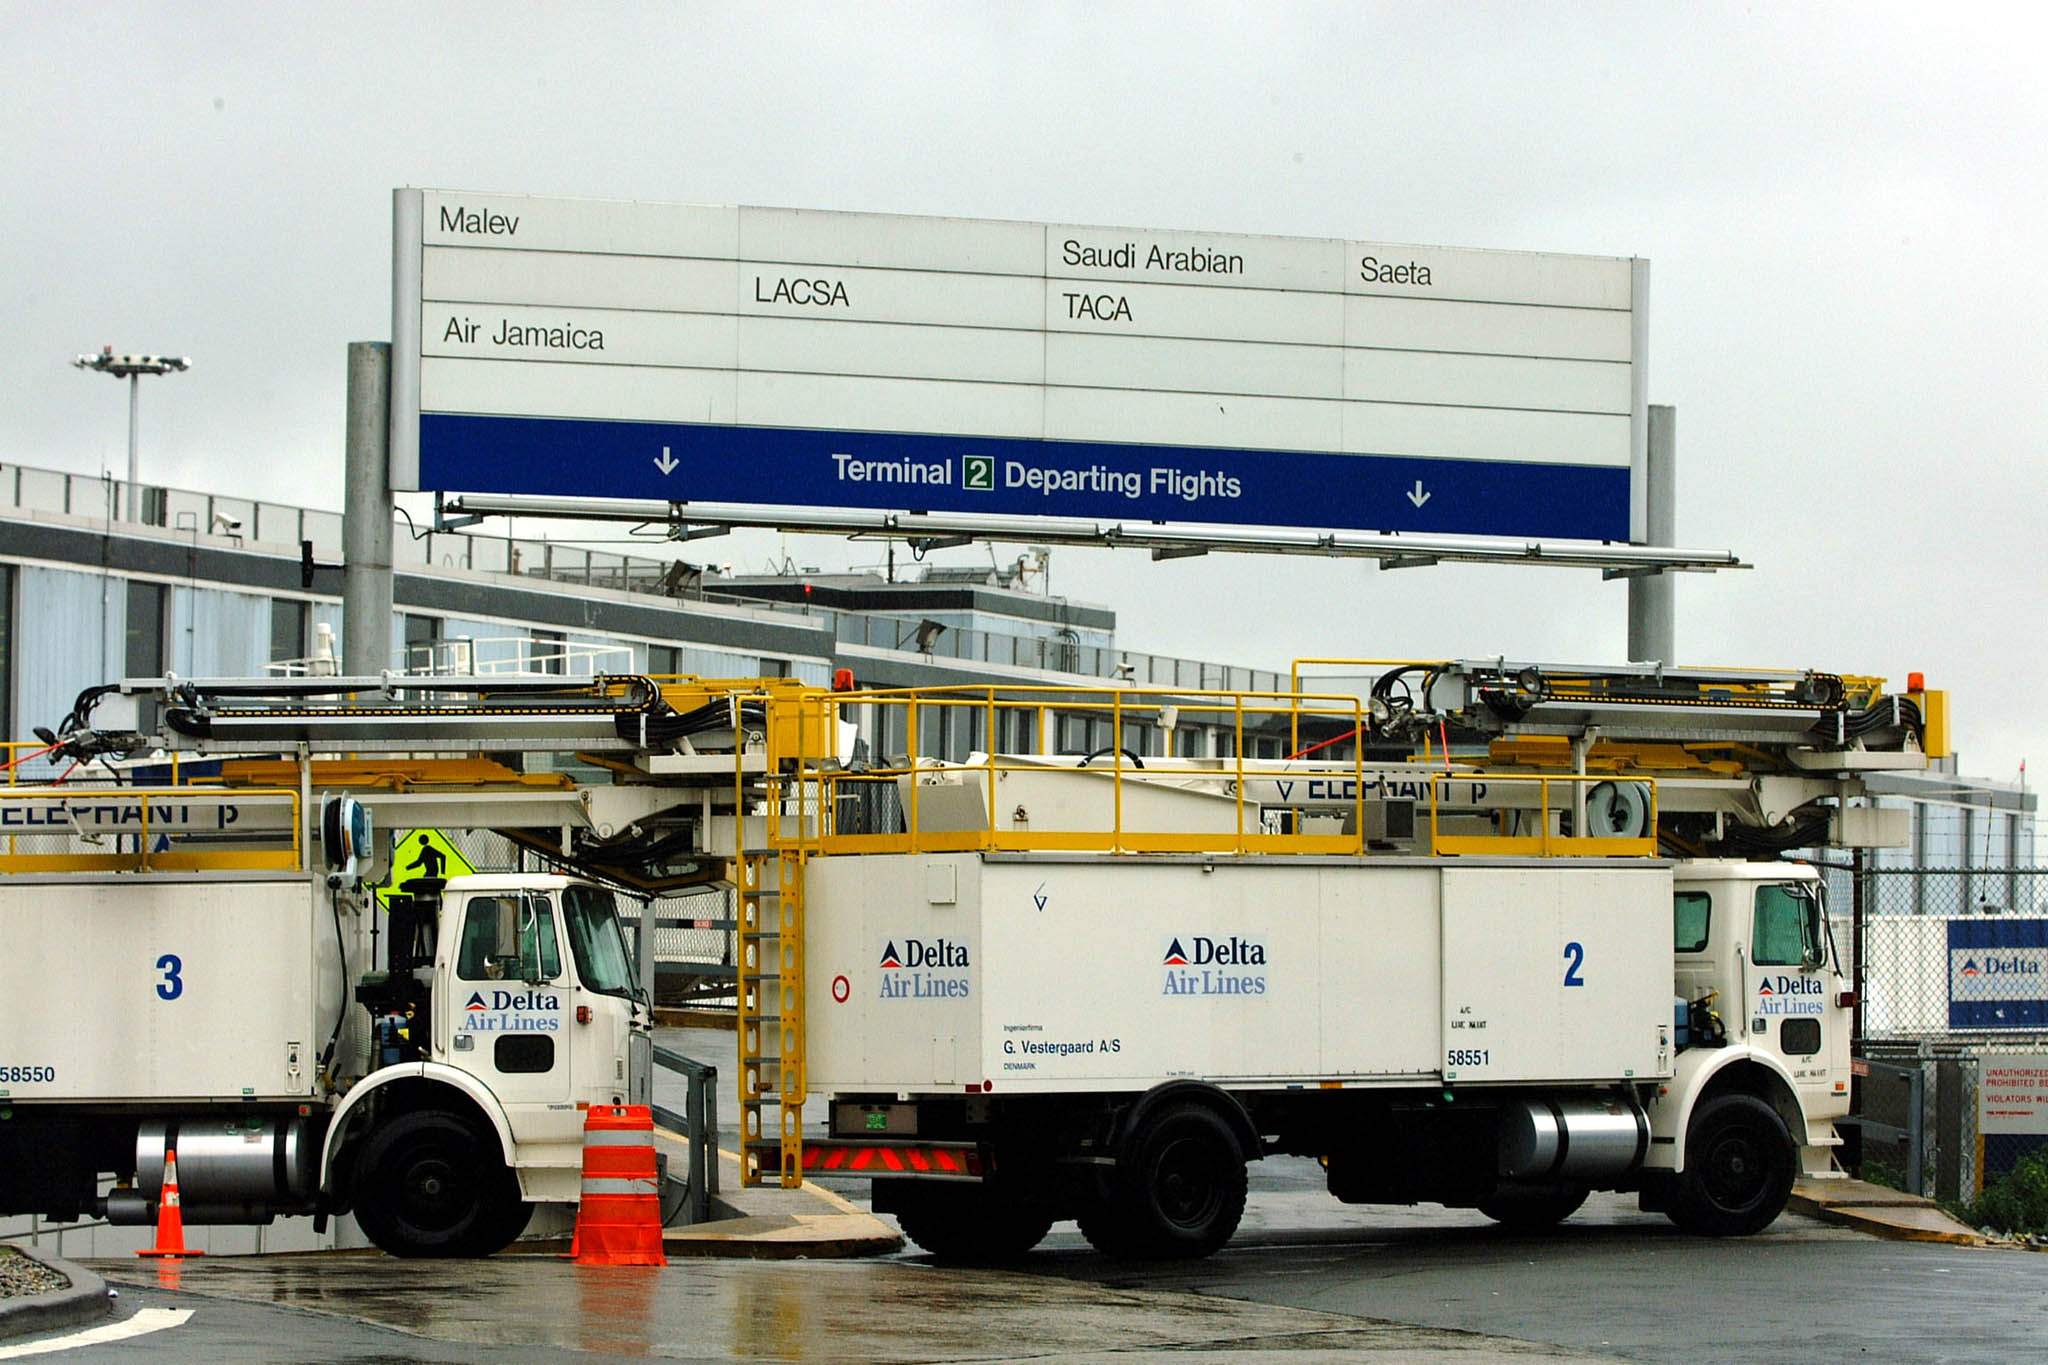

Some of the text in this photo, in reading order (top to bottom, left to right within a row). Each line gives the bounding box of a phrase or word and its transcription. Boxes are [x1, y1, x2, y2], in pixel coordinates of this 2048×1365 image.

[440, 206, 519, 235] Malev
[1062, 240, 1244, 274] Saudi Arabian
[1360, 256, 1433, 285] Saeta
[755, 277, 850, 307] LACSA
[1062, 293, 1133, 322] TACA
[443, 316, 605, 350] Air Jamaica
[831, 453, 1242, 501] Terminal 2 Departing Flights
[904, 938, 970, 968] Delta
[1192, 936, 1267, 965] Delta
[1563, 941, 1584, 987] 2
[156, 954, 183, 1001] 3
[1985, 957, 2038, 974] Delta
[879, 972, 969, 998] Air Lines
[1162, 970, 1266, 995] Air Lines
[1776, 975, 1823, 995] Delta
[491, 989, 560, 1011] Delta
[1759, 997, 1824, 1015] Air Lines
[464, 1013, 559, 1031] Air Lines
[1003, 1038, 1121, 1057] G. Vestergaard A/S
[1447, 1049, 1490, 1066] 58551
[0, 1066, 55, 1083] 58550
